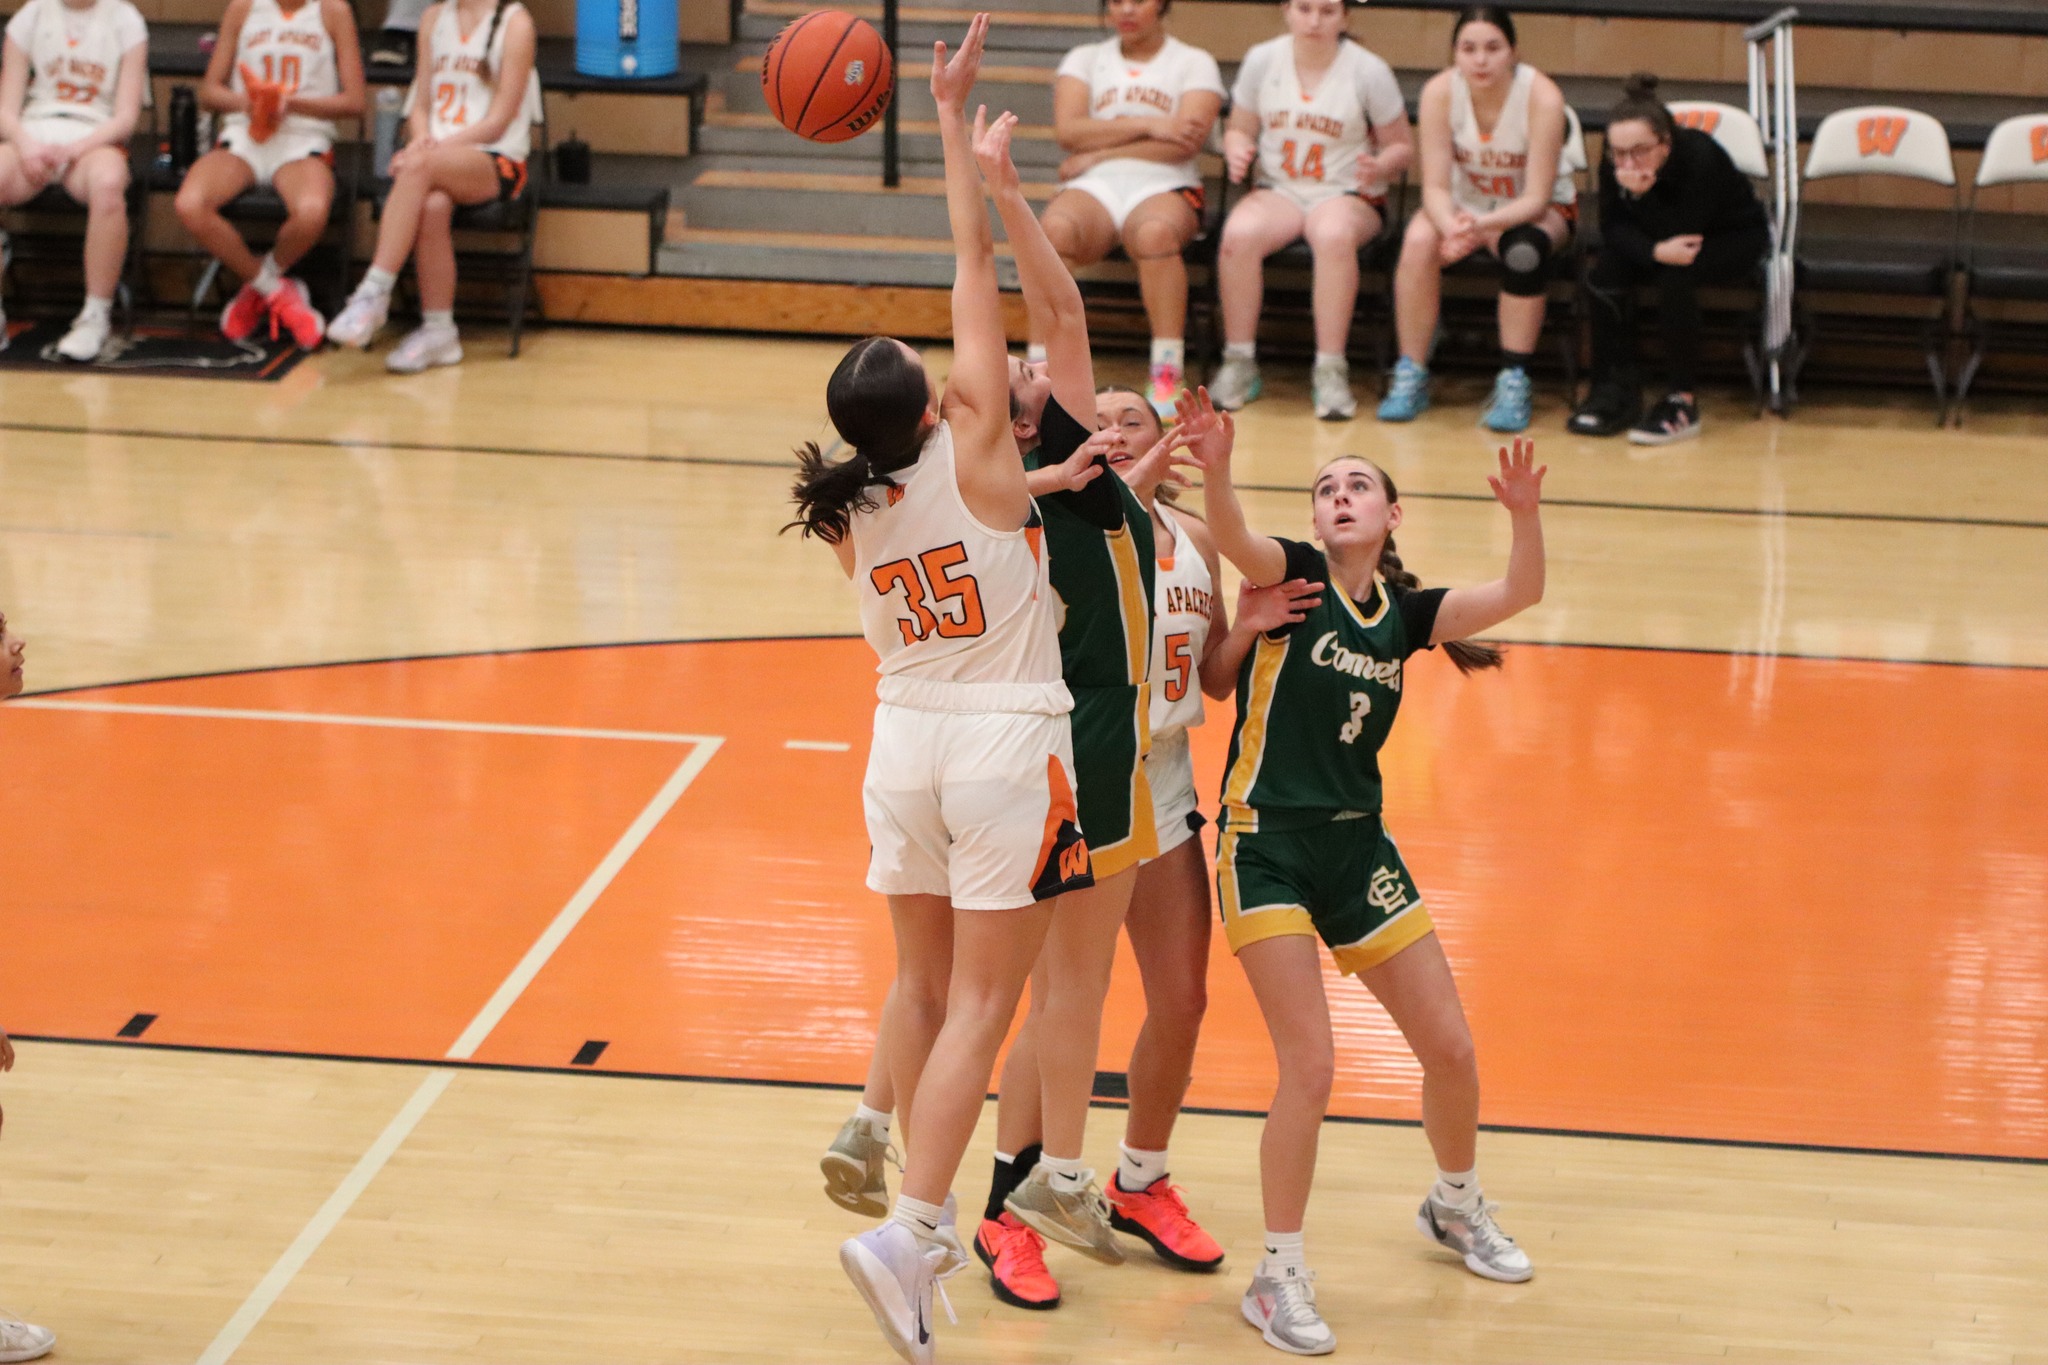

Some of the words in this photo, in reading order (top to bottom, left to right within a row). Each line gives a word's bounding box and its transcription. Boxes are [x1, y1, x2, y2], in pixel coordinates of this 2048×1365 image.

[1281, 139, 1325, 182] 14
[1857, 116, 1909, 156] W
[870, 541, 987, 647] 35
[1164, 632, 1192, 702] 5
[1339, 690, 1371, 744] 3
